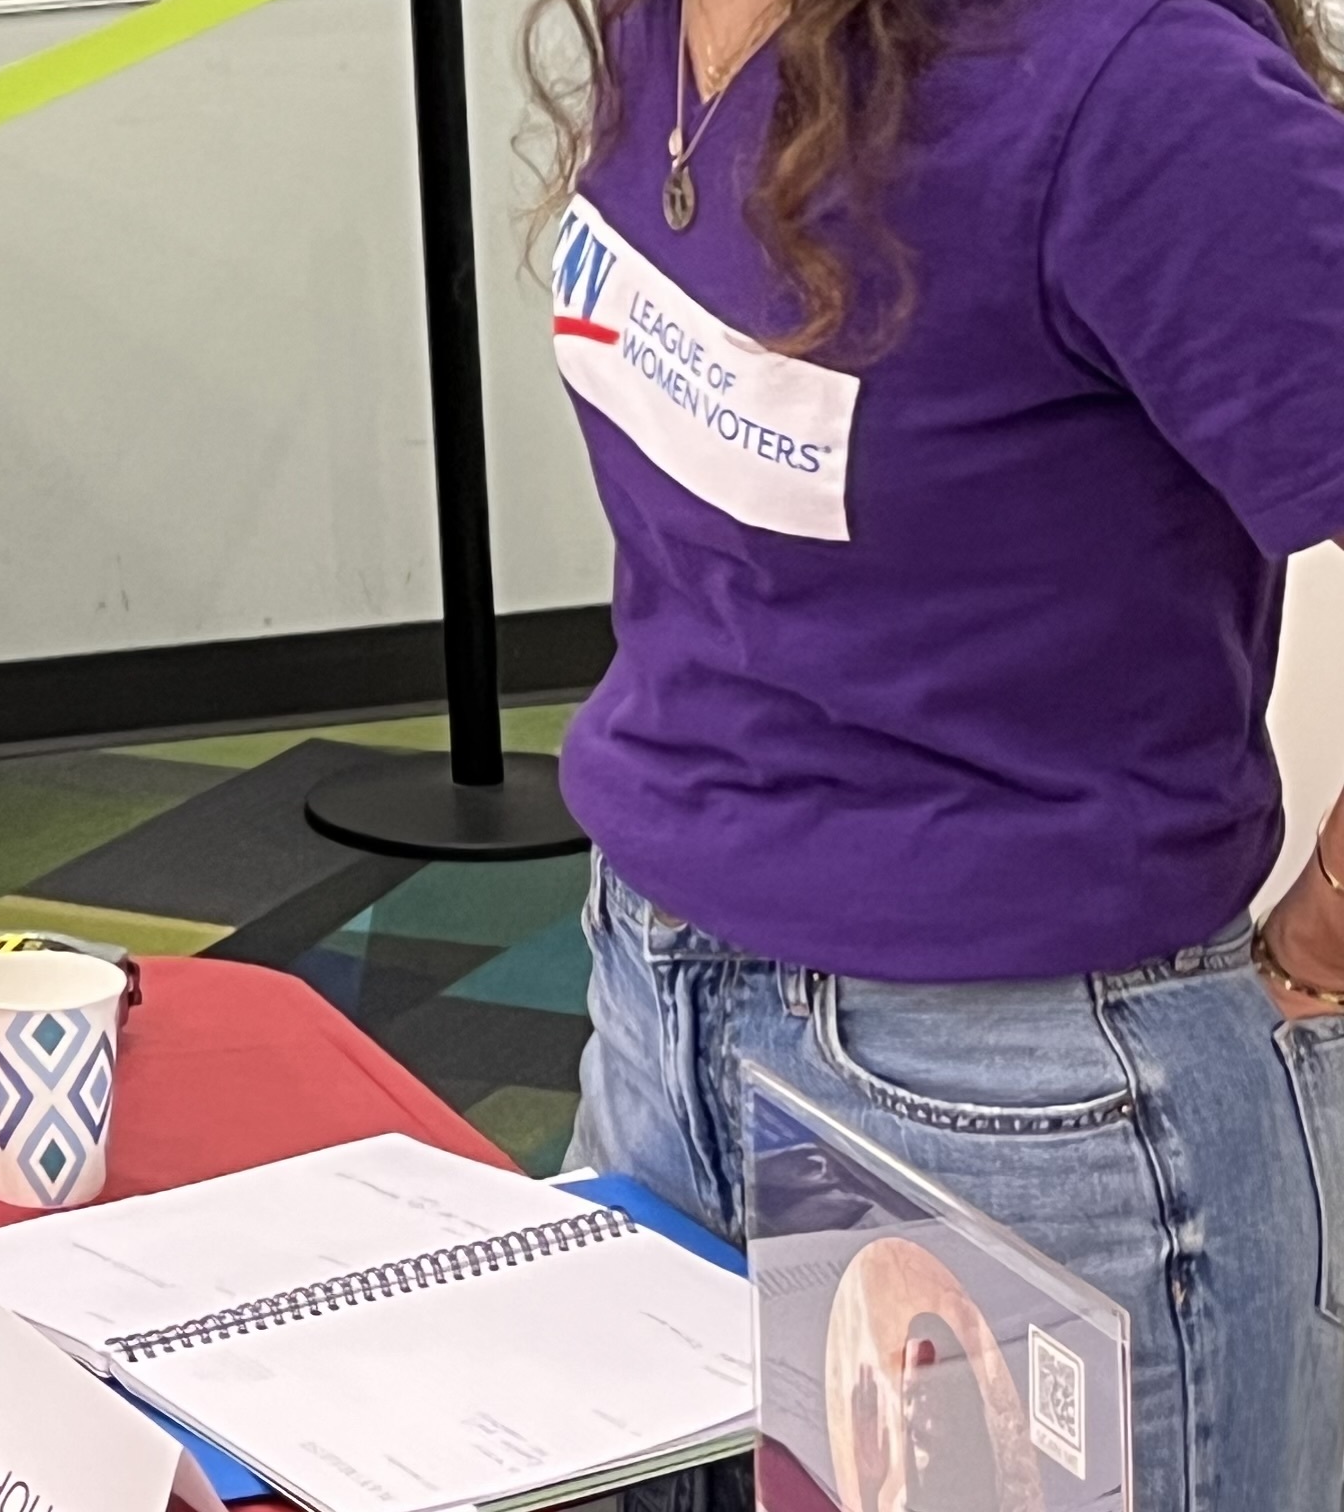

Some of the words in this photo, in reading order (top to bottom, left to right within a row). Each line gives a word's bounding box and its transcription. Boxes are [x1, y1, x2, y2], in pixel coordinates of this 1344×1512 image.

[622, 327, 701, 418] WOMEN
[628, 290, 705, 378] LEAGUE
[707, 362, 737, 397] OF
